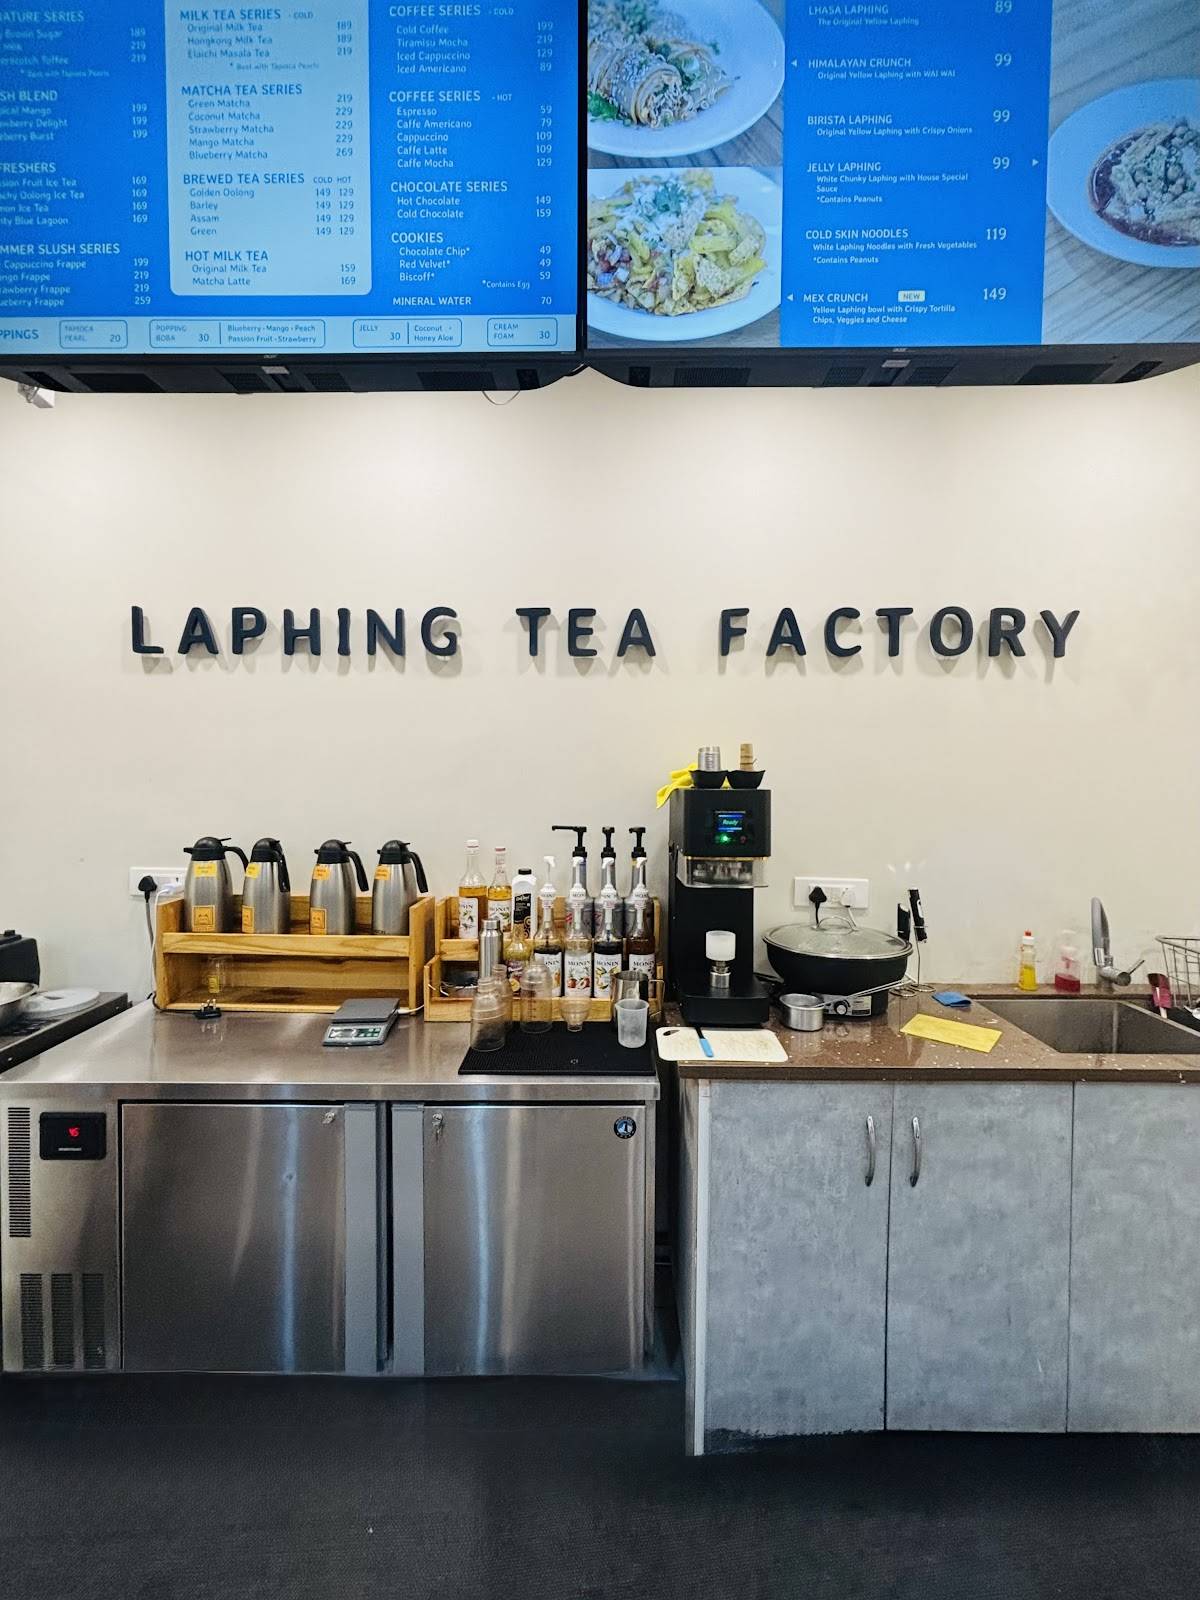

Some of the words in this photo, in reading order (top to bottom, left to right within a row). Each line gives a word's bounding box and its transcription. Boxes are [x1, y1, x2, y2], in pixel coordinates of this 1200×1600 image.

[389, 5, 435, 17] COFFEE
[439, 5, 481, 16] SERIES
[809, 5, 841, 16] LHASA
[844, 4, 888, 15] LAPHING
[180, 11, 209, 21] MILK
[213, 10, 235, 20] TEA
[240, 9, 281, 19] SERIES
[397, 39, 435, 47] Tiramisu
[418, 52, 470, 62] Cappuccino
[994, 53, 1012, 66] 99
[808, 59, 866, 68] HIMALAYAN
[869, 58, 912, 67] CRUNCH
[905, 70, 921, 78] with
[181, 86, 231, 96] MATCHA
[235, 85, 257, 95] TEA
[262, 84, 302, 95] SERIES
[19, 91, 58, 100] BLEND
[389, 91, 434, 102] COFFEE
[439, 90, 480, 101] SERIES
[396, 107, 437, 117] Espresso
[540, 105, 552, 113] 59
[807, 115, 846, 125] BIRISTA
[849, 114, 892, 124] LAPHING
[993, 110, 1010, 123] 99
[36, 120, 68, 128] Delight
[424, 120, 472, 128] Americano
[541, 119, 552, 127] 79
[189, 126, 238, 136] Strawberry
[817, 128, 846, 137] Original
[873, 127, 902, 137] Laphing
[904, 127, 920, 135] with
[336, 135, 353, 143] 229
[397, 133, 448, 143] Cappuccino
[536, 132, 552, 140] 109
[189, 138, 219, 149] Mango
[222, 138, 254, 146] Matcha
[424, 146, 447, 154] Latte
[536, 145, 552, 153] 109
[189, 151, 232, 160] Blueberry
[424, 159, 454, 167] Mocha
[537, 158, 552, 166] 129
[993, 157, 1010, 170] 99
[807, 163, 834, 173] JELLY
[837, 162, 881, 172] LAPHING
[183, 174, 233, 184] BREWED
[237, 174, 260, 184] TEA
[264, 173, 305, 184] SERIES
[817, 175, 837, 183] White
[839, 174, 866, 184] Chunky
[868, 174, 897, 183] Laphing
[899, 174, 915, 182] with
[942, 173, 968, 182] Special
[391, 182, 462, 193] CHOCOLATE
[467, 181, 508, 192] SERIES
[816, 185, 838, 193] Sauce
[190, 188, 220, 197] Golden
[316, 188, 330, 197] 149
[339, 188, 353, 196] 129
[397, 197, 413, 206] Hot
[415, 197, 460, 205] Chocolate
[536, 196, 551, 204] 149
[854, 195, 883, 203] Peanuts
[190, 201, 218, 211] Barley
[316, 201, 331, 210] 149
[339, 201, 353, 209] 129
[397, 209, 417, 218] Cold
[420, 209, 464, 218] Chocolate
[536, 209, 551, 217] 159
[15, 217, 34, 225] Blue
[37, 217, 68, 227] Lagoon
[339, 214, 354, 222] 129
[316, 227, 331, 235] 149
[340, 227, 354, 235] 129
[806, 230, 832, 239] COLD
[835, 229, 858, 239] SKIN
[861, 228, 908, 239] NOODLES
[986, 228, 1007, 240] 119
[392, 232, 444, 243] COOKIES
[38, 244, 76, 254] SLUSH
[80, 243, 120, 253] SERIES
[539, 245, 551, 254] 49
[813, 243, 834, 251] White
[835, 242, 864, 252] Laphing
[866, 242, 895, 250] Noodles
[915, 241, 935, 249] Fresh
[938, 241, 977, 250] Vegetables
[185, 251, 209, 261] HOT
[213, 251, 242, 261] MILK
[246, 250, 268, 260] TEA
[400, 247, 444, 256] Chocolate
[400, 260, 416, 268] Red
[539, 259, 551, 267] 49
[850, 256, 879, 264] Peanuts
[4, 261, 54, 270] Cappuccino
[192, 265, 226, 275] Original
[230, 264, 248, 272] Milk
[251, 264, 266, 272] Tea
[341, 264, 356, 272] 159
[540, 271, 551, 280] 59
[228, 277, 250, 285] Latte
[341, 277, 356, 285] 169
[517, 281, 530, 289] Egg
[803, 293, 825, 303] MEX
[827, 293, 868, 303] CRUNCH
[902, 292, 920, 300] NEW
[983, 288, 1007, 301] 149
[393, 297, 435, 306] MINERAL
[438, 297, 472, 305] WATER
[813, 306, 836, 314] Yellow
[837, 305, 866, 315] Laphing
[868, 305, 885, 313] bowl
[887, 304, 903, 312] with
[905, 304, 927, 314] Crispy
[929, 304, 955, 312] Tortilla
[837, 315, 864, 325] Veggies
[866, 315, 880, 323] and
[882, 315, 907, 323] Cheese
[227, 325, 261, 333] Blueberry
[266, 325, 289, 333] Mango
[198, 334, 209, 342] 30
[390, 332, 400, 340] 30
[414, 334, 435, 342] Honey
[539, 331, 550, 339] 30
[131, 605, 460, 658] LAPHING
[515, 607, 656, 658] TEA
[720, 605, 1081, 659] FACTORY
